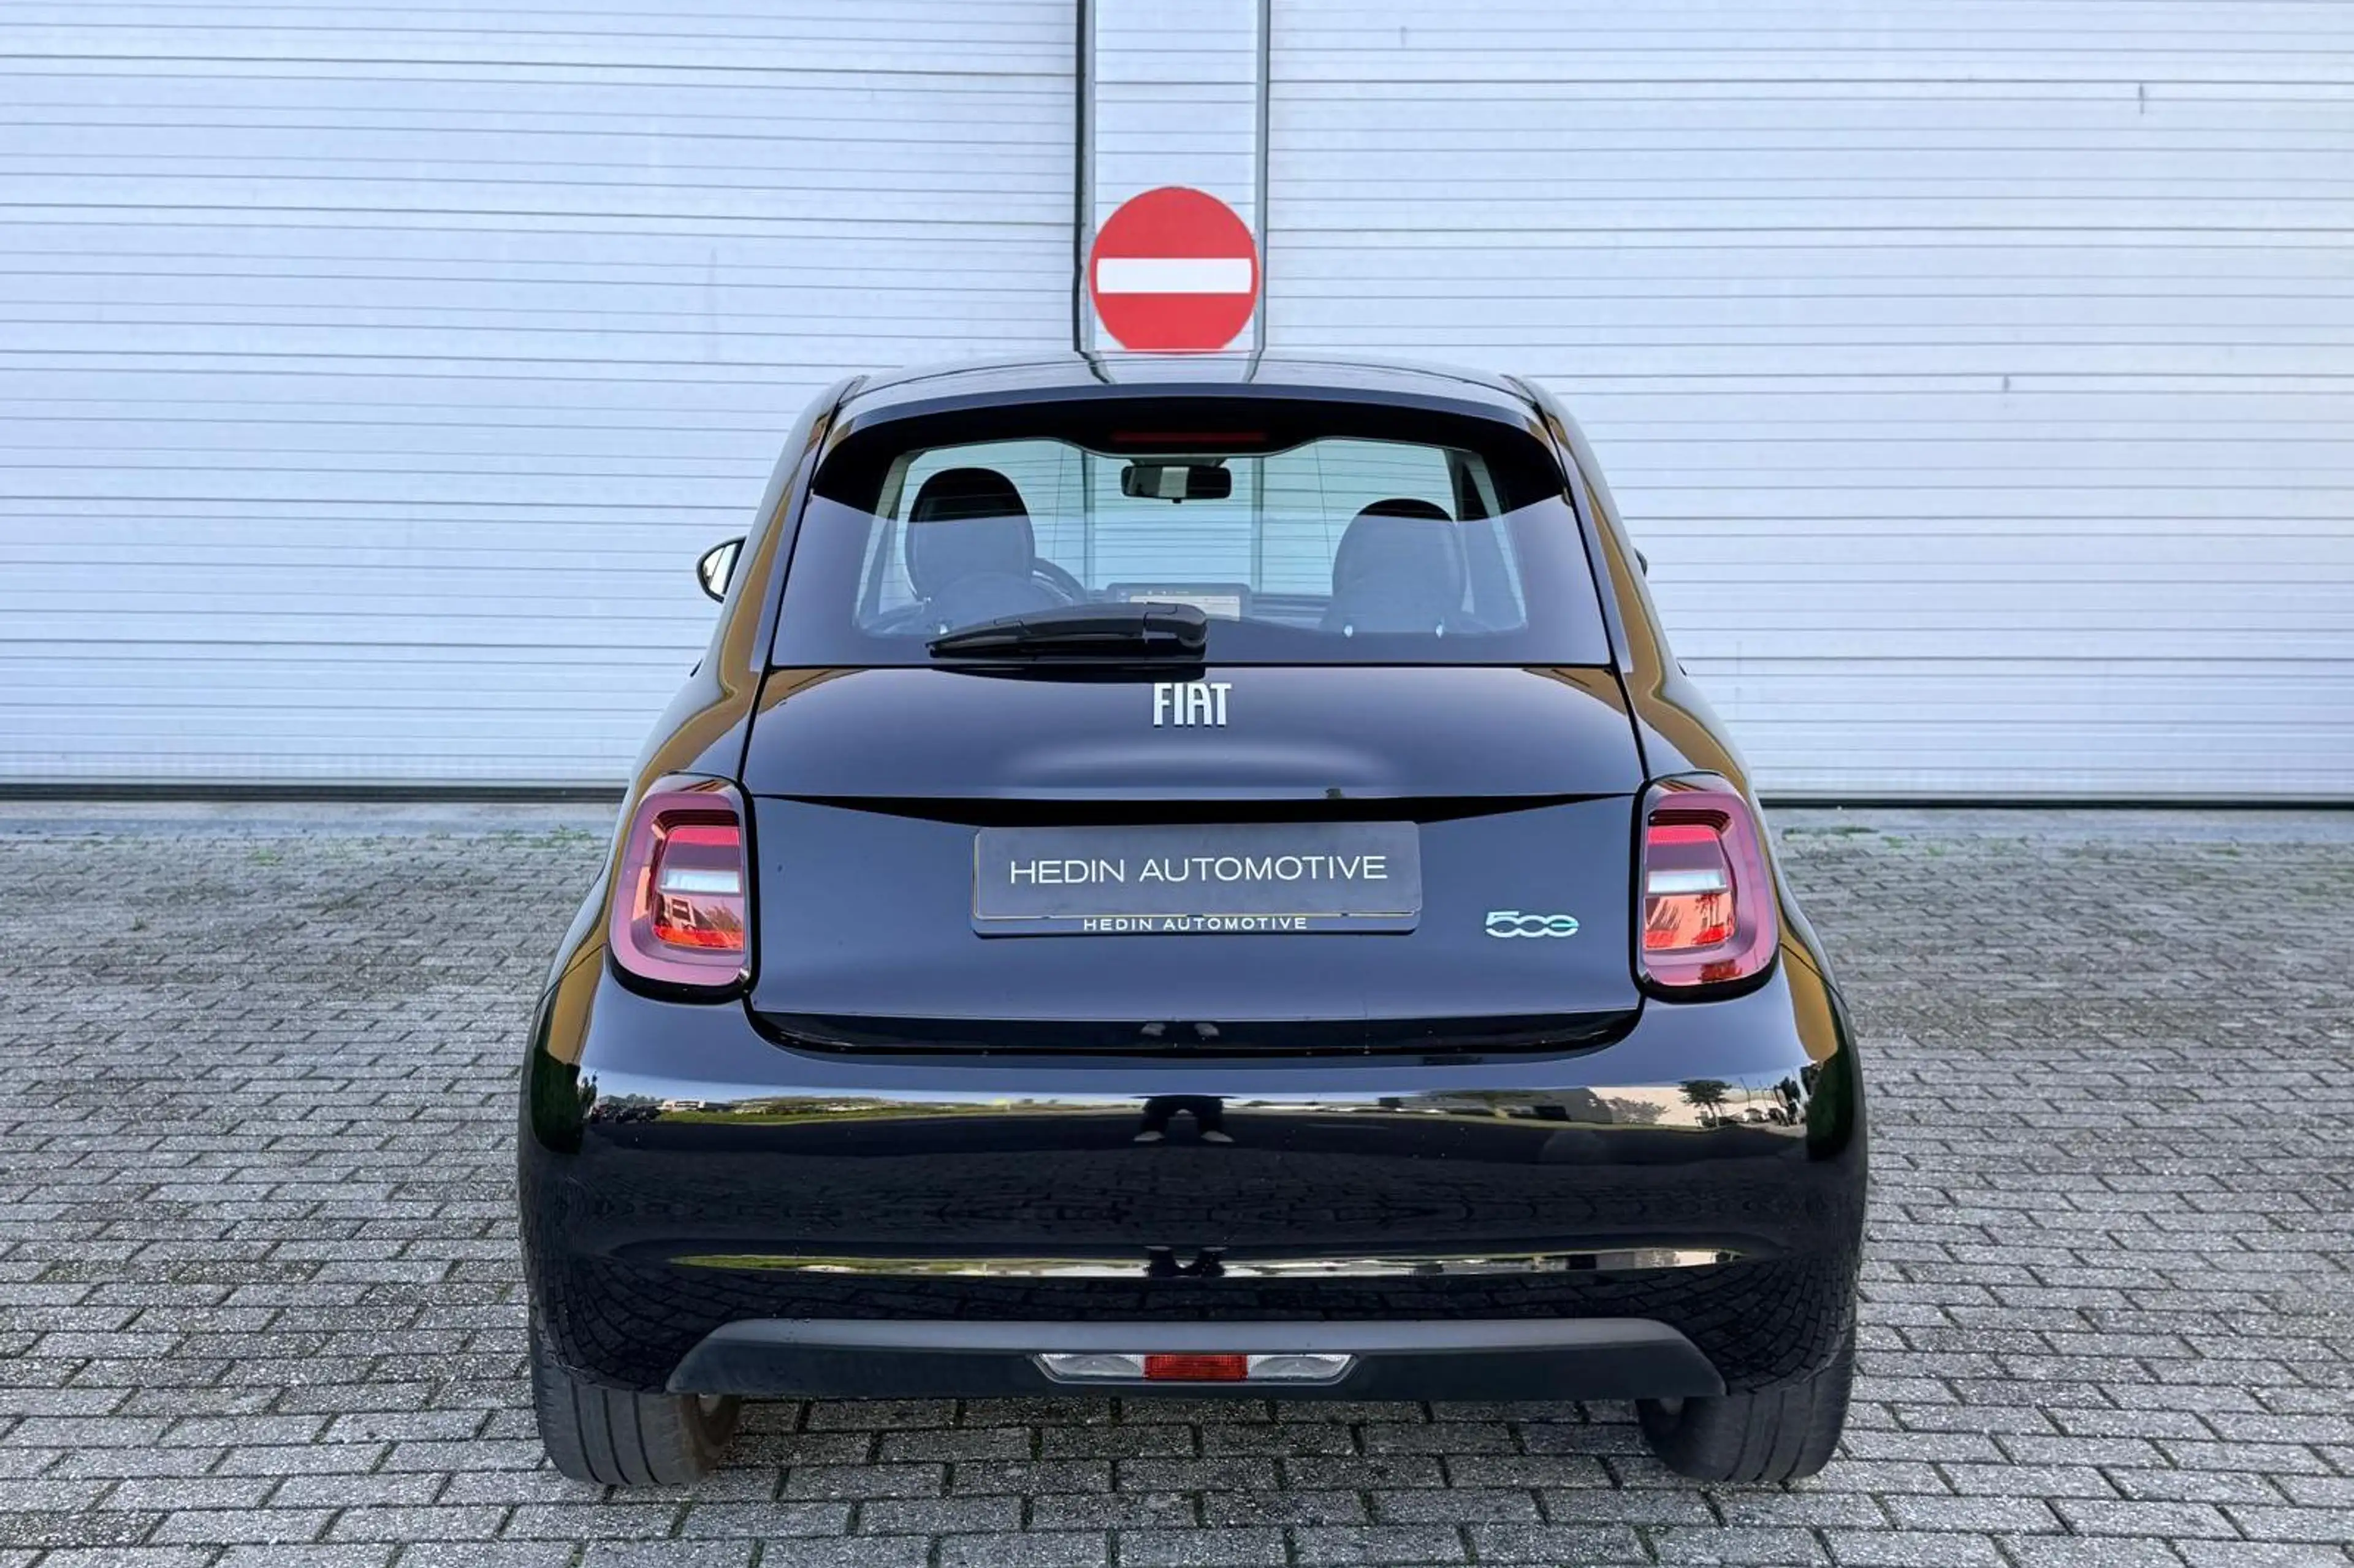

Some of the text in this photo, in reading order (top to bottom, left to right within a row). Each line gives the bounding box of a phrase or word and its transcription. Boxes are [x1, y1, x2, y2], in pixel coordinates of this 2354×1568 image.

[1153, 682, 1232, 725] FIAT
[1010, 856, 1388, 884] HEDIN AUTOMOTIVE
[1083, 917, 1308, 931] HEDIN AUTOMOTIVE
